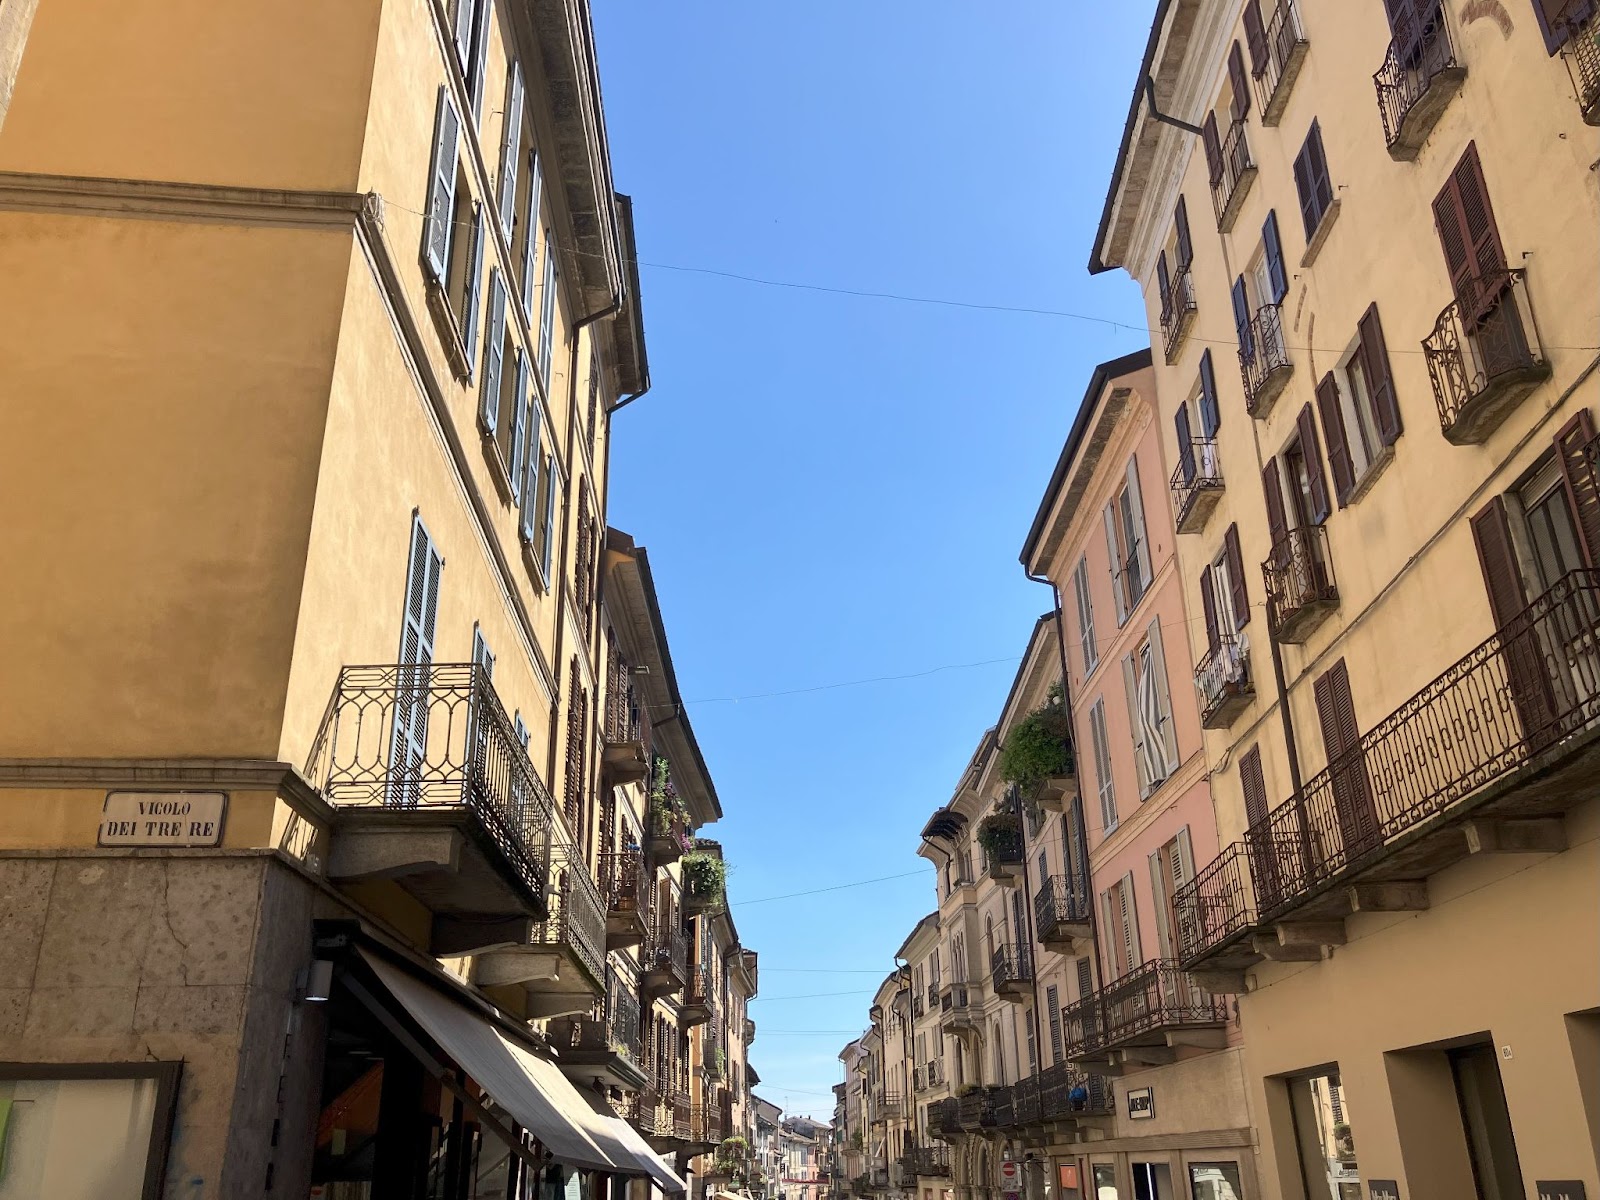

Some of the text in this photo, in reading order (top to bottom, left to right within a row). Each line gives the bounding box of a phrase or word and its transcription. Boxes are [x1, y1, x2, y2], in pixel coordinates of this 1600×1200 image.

[138, 801, 191, 816] VICOLO
[107, 821, 214, 837] DEI TRE RE
